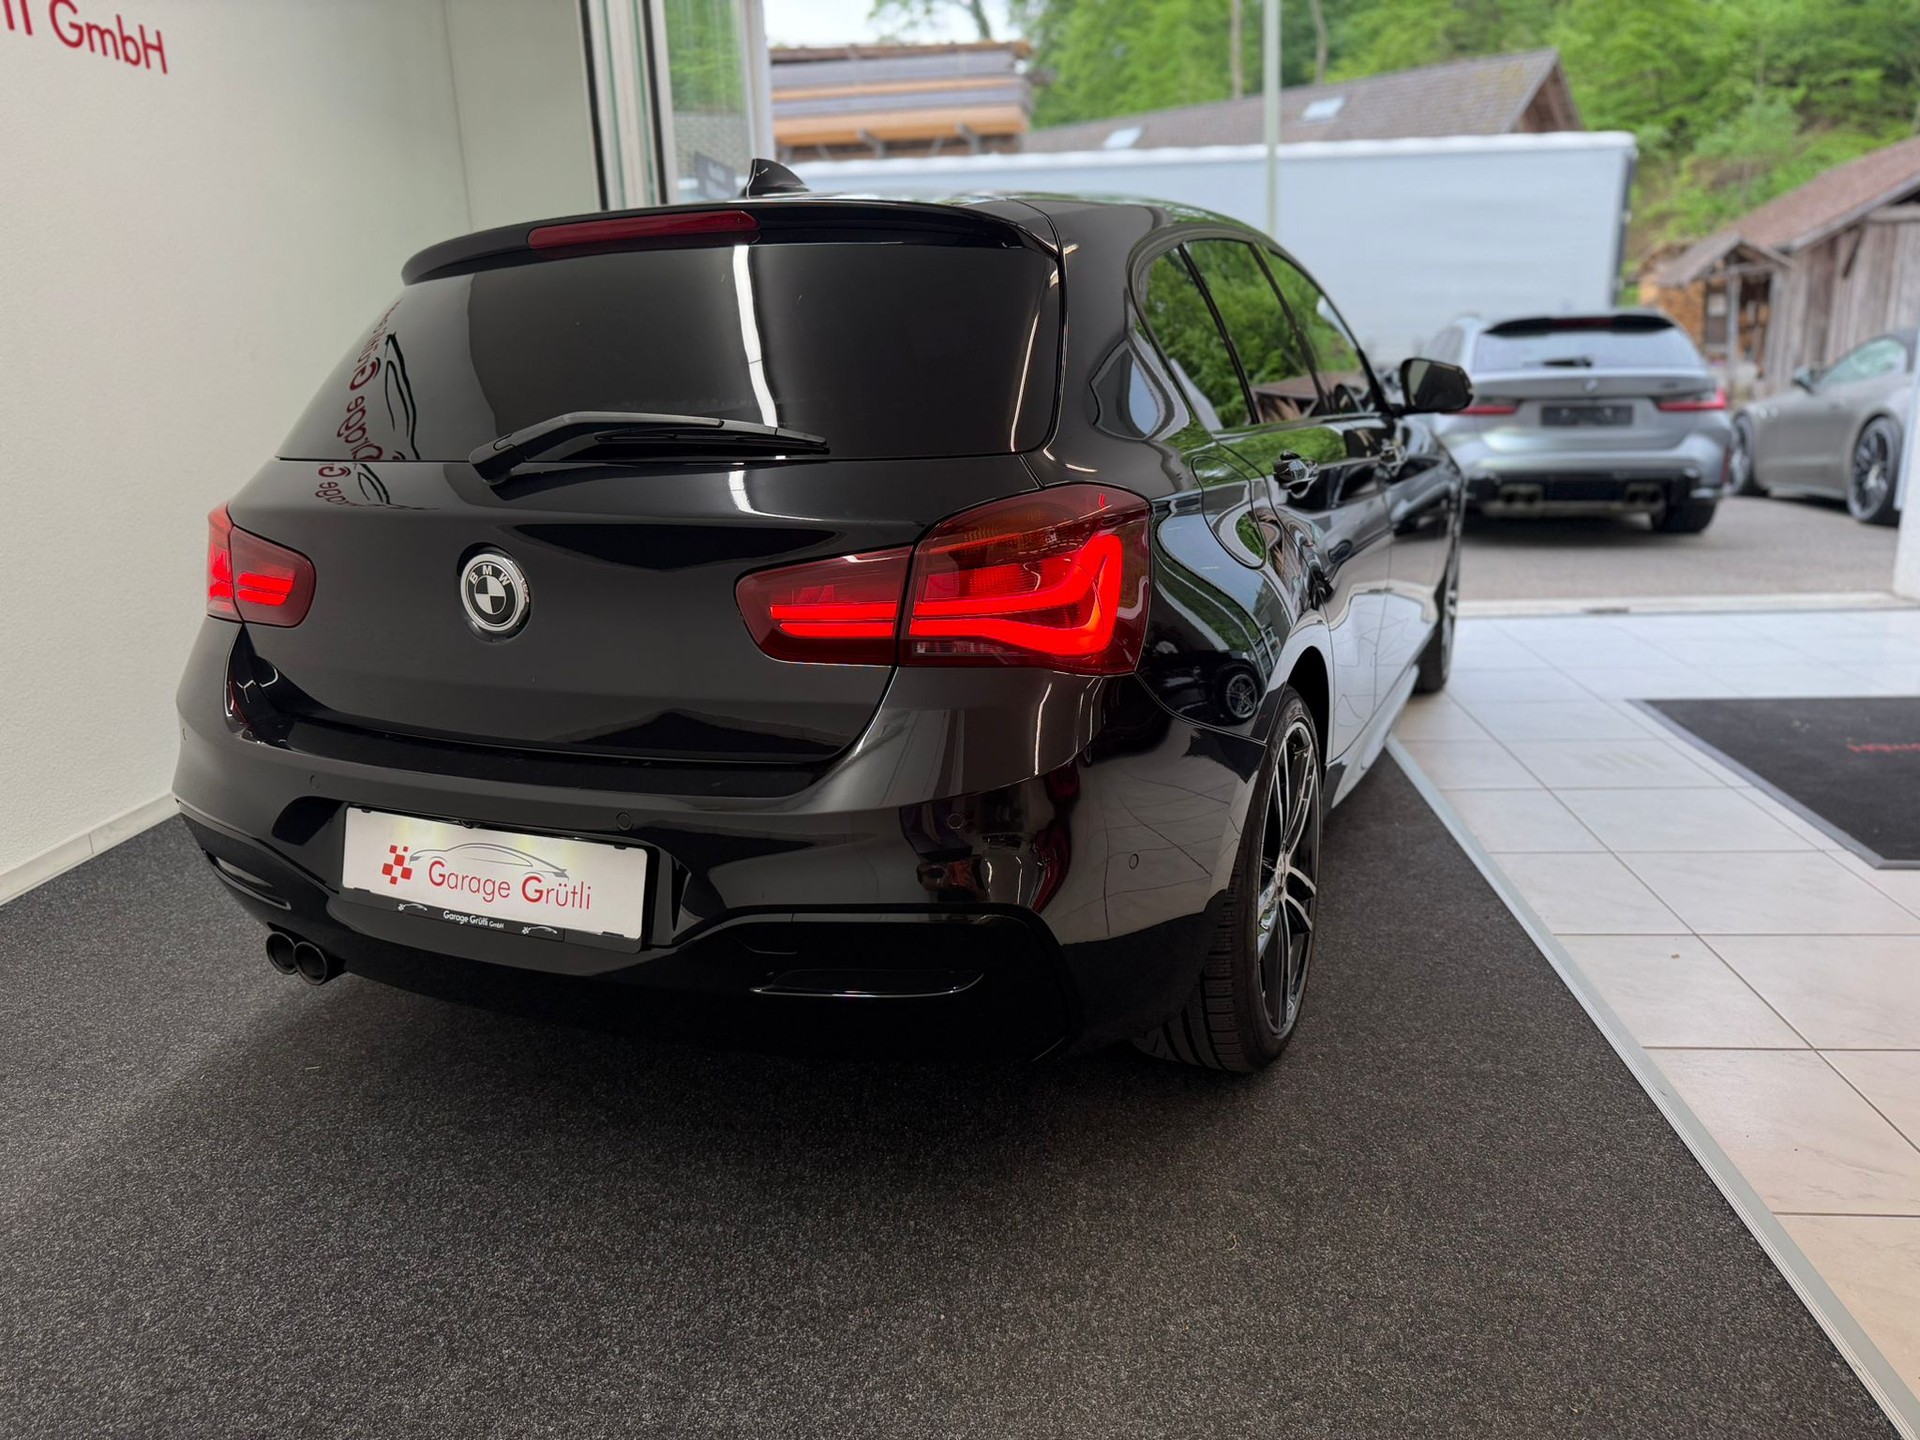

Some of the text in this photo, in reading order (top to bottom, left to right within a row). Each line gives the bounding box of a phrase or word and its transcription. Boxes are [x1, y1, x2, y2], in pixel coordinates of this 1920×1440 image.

[49, 0, 168, 74] GmbH
[469, 565, 512, 586] BMW
[428, 860, 592, 910] Garage Grütli
[443, 910, 504, 929] Garage Grütli GmbH
